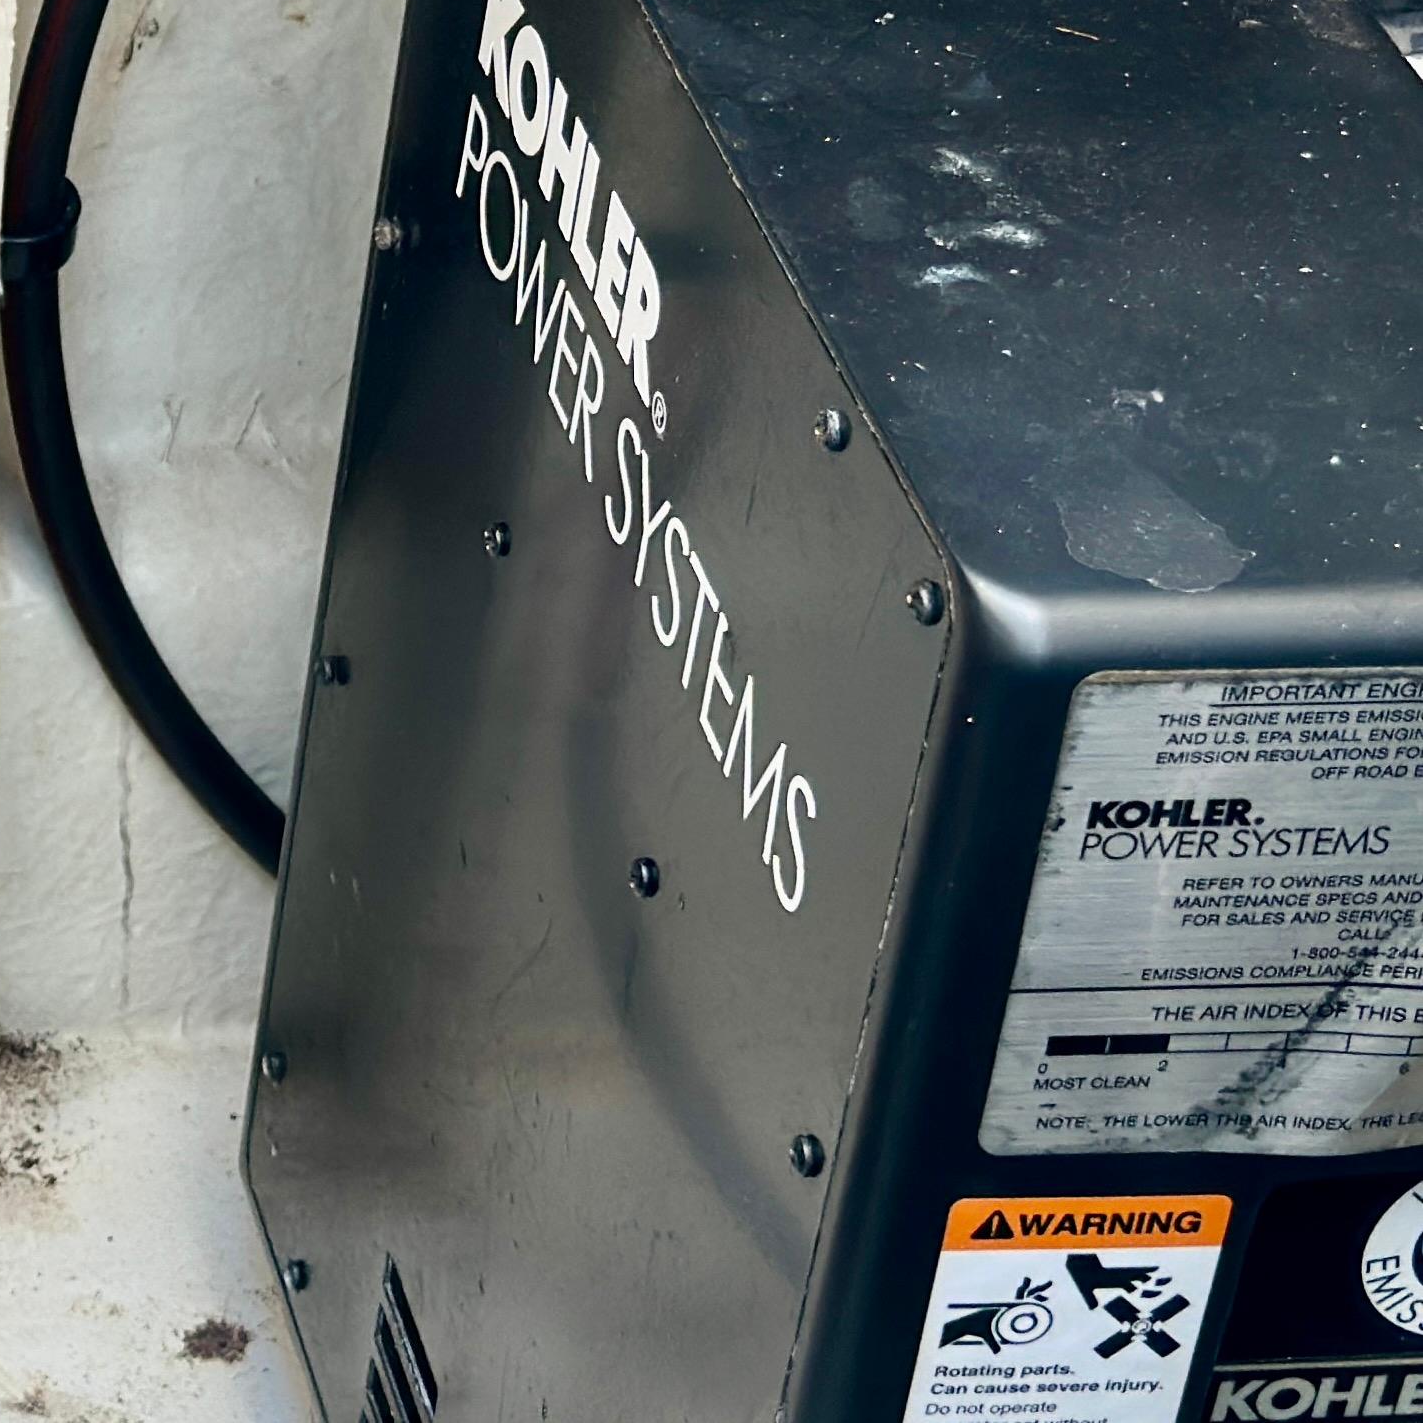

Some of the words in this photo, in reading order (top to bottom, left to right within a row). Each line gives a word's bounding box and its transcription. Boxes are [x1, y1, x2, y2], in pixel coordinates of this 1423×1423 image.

[456, 93, 604, 484] POWER
[604, 417, 817, 914] SYSTEMS
[1221, 684, 1362, 702] IMPORTANT
[1158, 714, 1202, 728] THIS
[1207, 712, 1280, 727] ENGINE
[1285, 711, 1350, 725] MEETS
[1165, 732, 1208, 745] AND
[1213, 731, 1249, 745] U.S.
[1257, 731, 1293, 744] EPA
[1298, 729, 1362, 743] SMALL
[1155, 751, 1250, 765] EMISSION
[1255, 748, 1389, 763] REGULATIONS
[1311, 766, 1348, 780] OFF
[1354, 765, 1408, 779] ROAD
[1080, 831, 1219, 861] POWER
[1228, 826, 1392, 859] SYSTEMS
[1182, 877, 1244, 892] REFER
[1251, 876, 1275, 890] TO
[1281, 875, 1364, 889] OWNERS
[1173, 894, 1311, 910] MAINTENANCE
[1315, 892, 1378, 907] SPECS
[1383, 891, 1423, 905] AND
[1181, 913, 1220, 927] FOR
[1226, 911, 1286, 926] SALES
[1291, 910, 1331, 924] AND
[1336, 908, 1415, 924] SERVICE
[1291, 945, 1423, 961] 1-800-544-244
[1141, 966, 1244, 981] EMISSIONS
[1250, 963, 1375, 980] COMPLIANCE
[1152, 1006, 1196, 1022] THE
[1199, 1005, 1240, 1020] AIR
[1244, 1004, 1311, 1020] INDEX
[1318, 1001, 1351, 1019] OF
[1355, 1005, 1408, 1024] THIS
[1038, 1063, 1048, 1075] 0
[1157, 1060, 1168, 1072] 2
[1033, 1076, 1087, 1091] MOST
[1091, 1076, 1151, 1089] CLEAN
[1036, 1114, 1090, 1129] NOTE:
[1103, 1114, 1138, 1128] THE
[1143, 1113, 1208, 1128] LOWER
[1216, 1114, 1252, 1128] THE
[1256, 1114, 1286, 1128] AIR
[1360, 1115, 1394, 1127] THE
[1017, 1211, 1203, 1236] WARNING
[934, 1365, 1015, 1379] Rotating
[1021, 1364, 1075, 1378] parts.
[930, 1383, 968, 1395] Can
[974, 1383, 1029, 1394] cause
[1037, 1380, 1100, 1394] severe
[1105, 1379, 1164, 1394] injury.
[925, 1403, 951, 1416] Do
[955, 1403, 985, 1415] not
[989, 1402, 1057, 1416] operate
